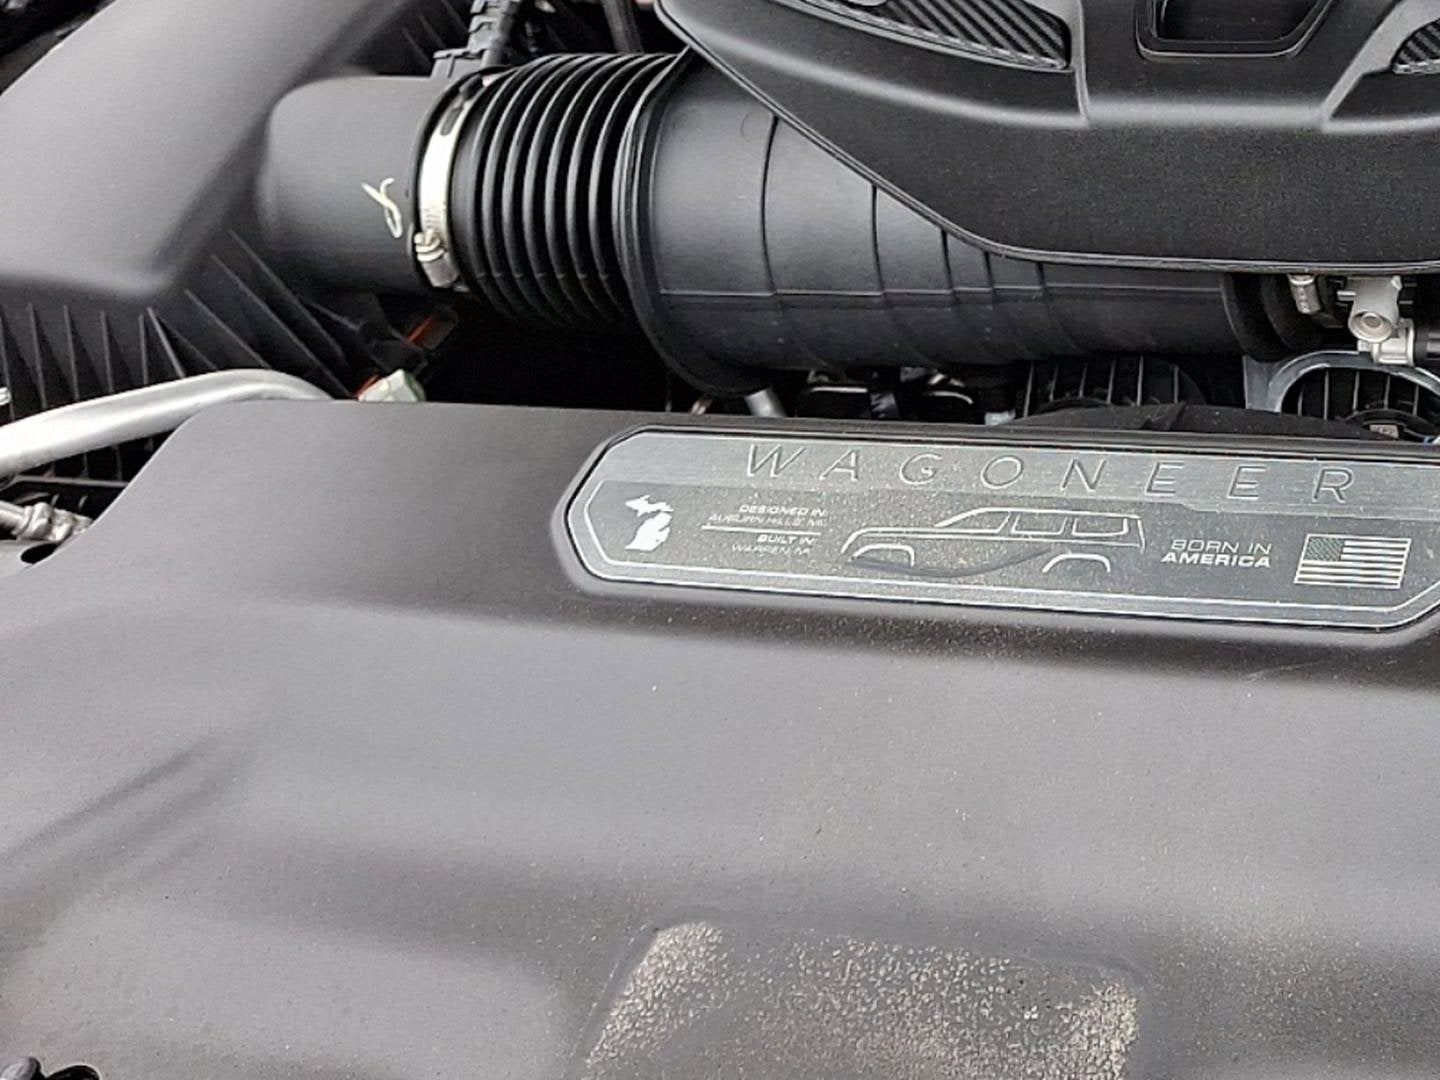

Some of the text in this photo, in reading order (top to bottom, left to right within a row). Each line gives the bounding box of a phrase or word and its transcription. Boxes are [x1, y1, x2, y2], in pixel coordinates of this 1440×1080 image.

[747, 443, 1356, 504] WAGONEER
[757, 534, 797, 545] BUILT
[1170, 538, 1273, 555] BORN IN
[1161, 551, 1272, 569] AMERICA
